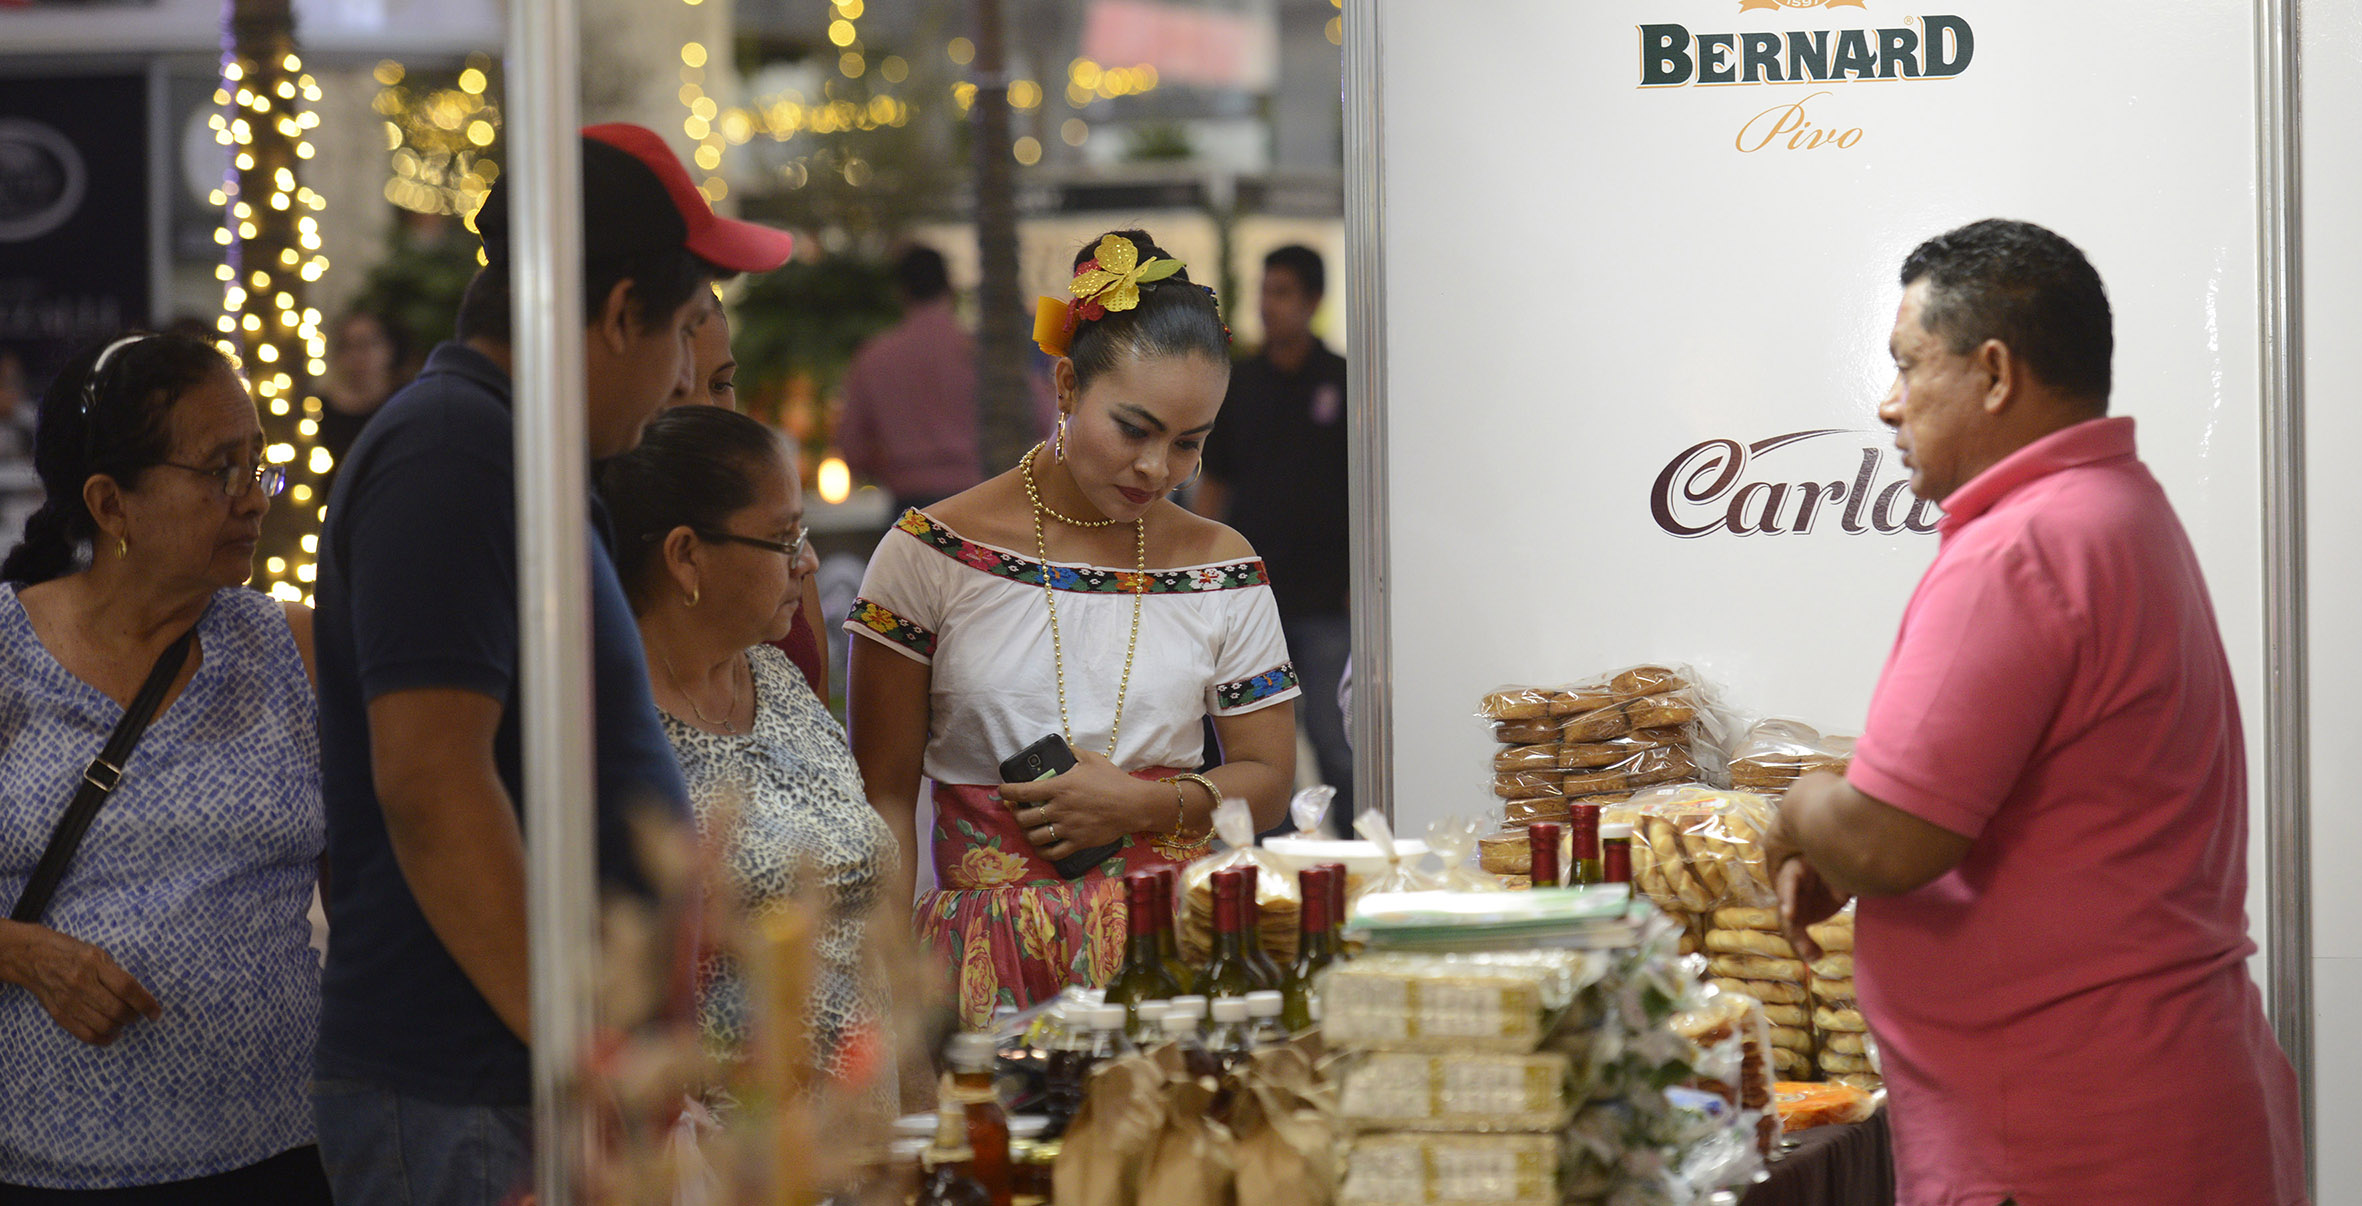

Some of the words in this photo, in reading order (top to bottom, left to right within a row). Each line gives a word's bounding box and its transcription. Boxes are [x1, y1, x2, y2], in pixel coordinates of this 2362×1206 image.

[1636, 14, 1974, 89] BERNARD
[1735, 91, 1863, 153] Pivo
[1650, 436, 1943, 539] Carla
